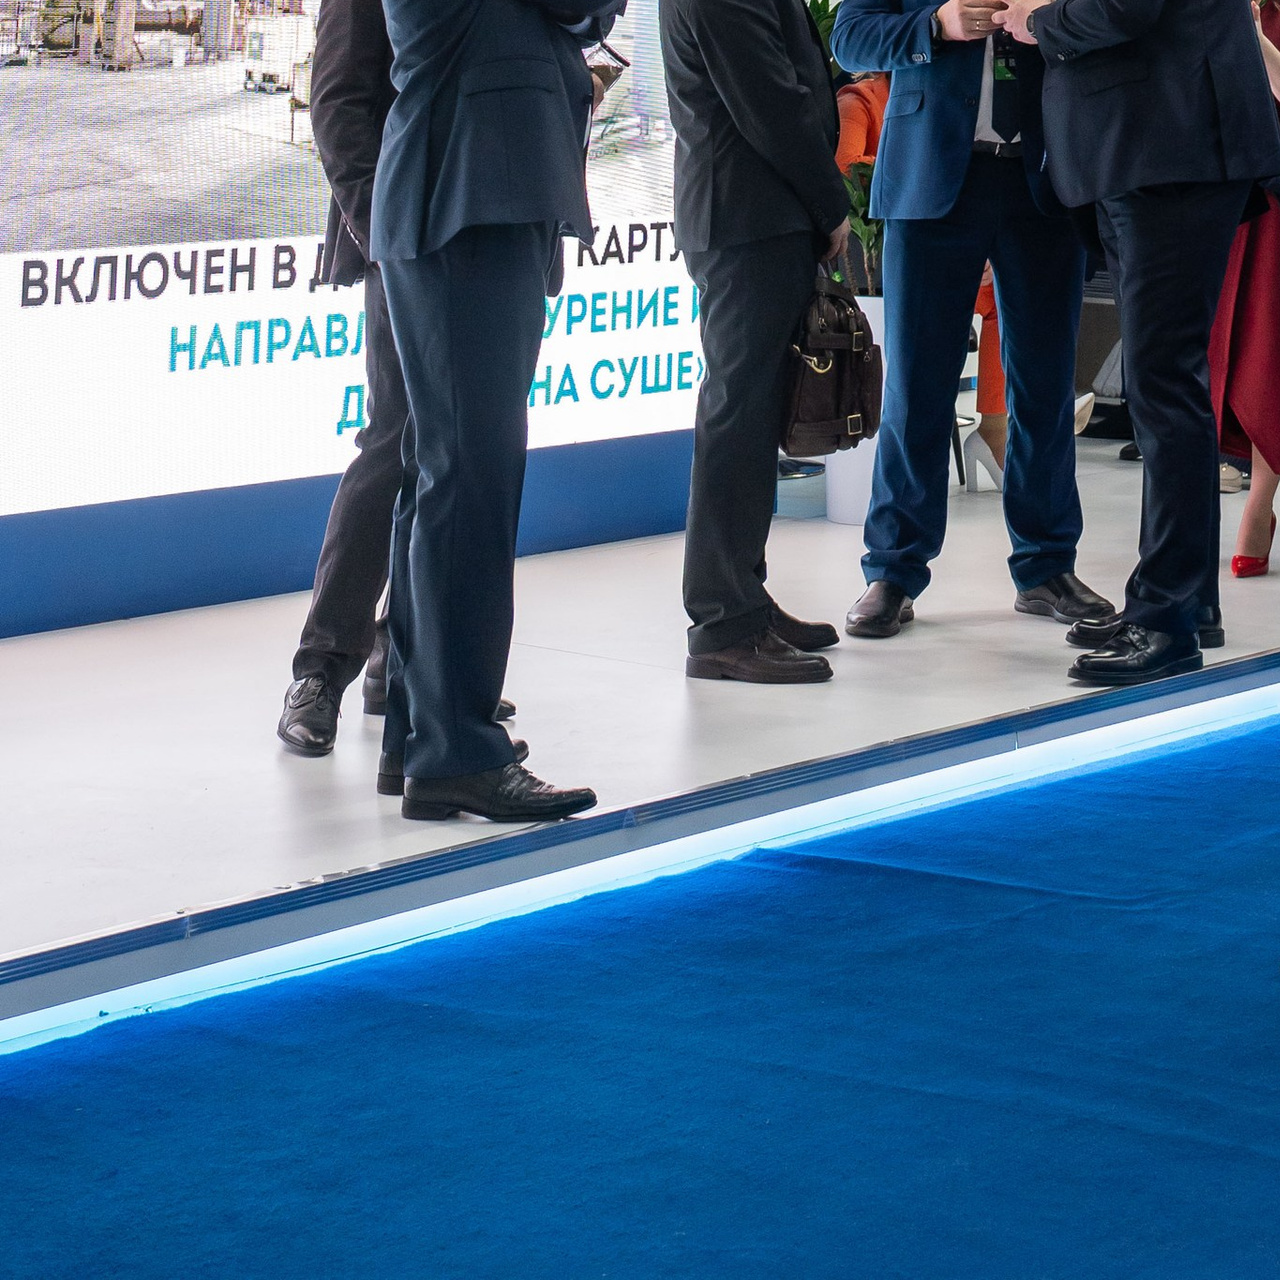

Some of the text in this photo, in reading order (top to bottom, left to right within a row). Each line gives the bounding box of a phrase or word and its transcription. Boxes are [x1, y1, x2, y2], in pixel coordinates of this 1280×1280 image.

[21, 246, 257, 307] ВКЛЮЧЕН
[272, 244, 297, 289] В
[168, 311, 365, 373] НАПРАВ
[542, 286, 679, 339] УРЕНИЕ
[529, 363, 580, 407] НА
